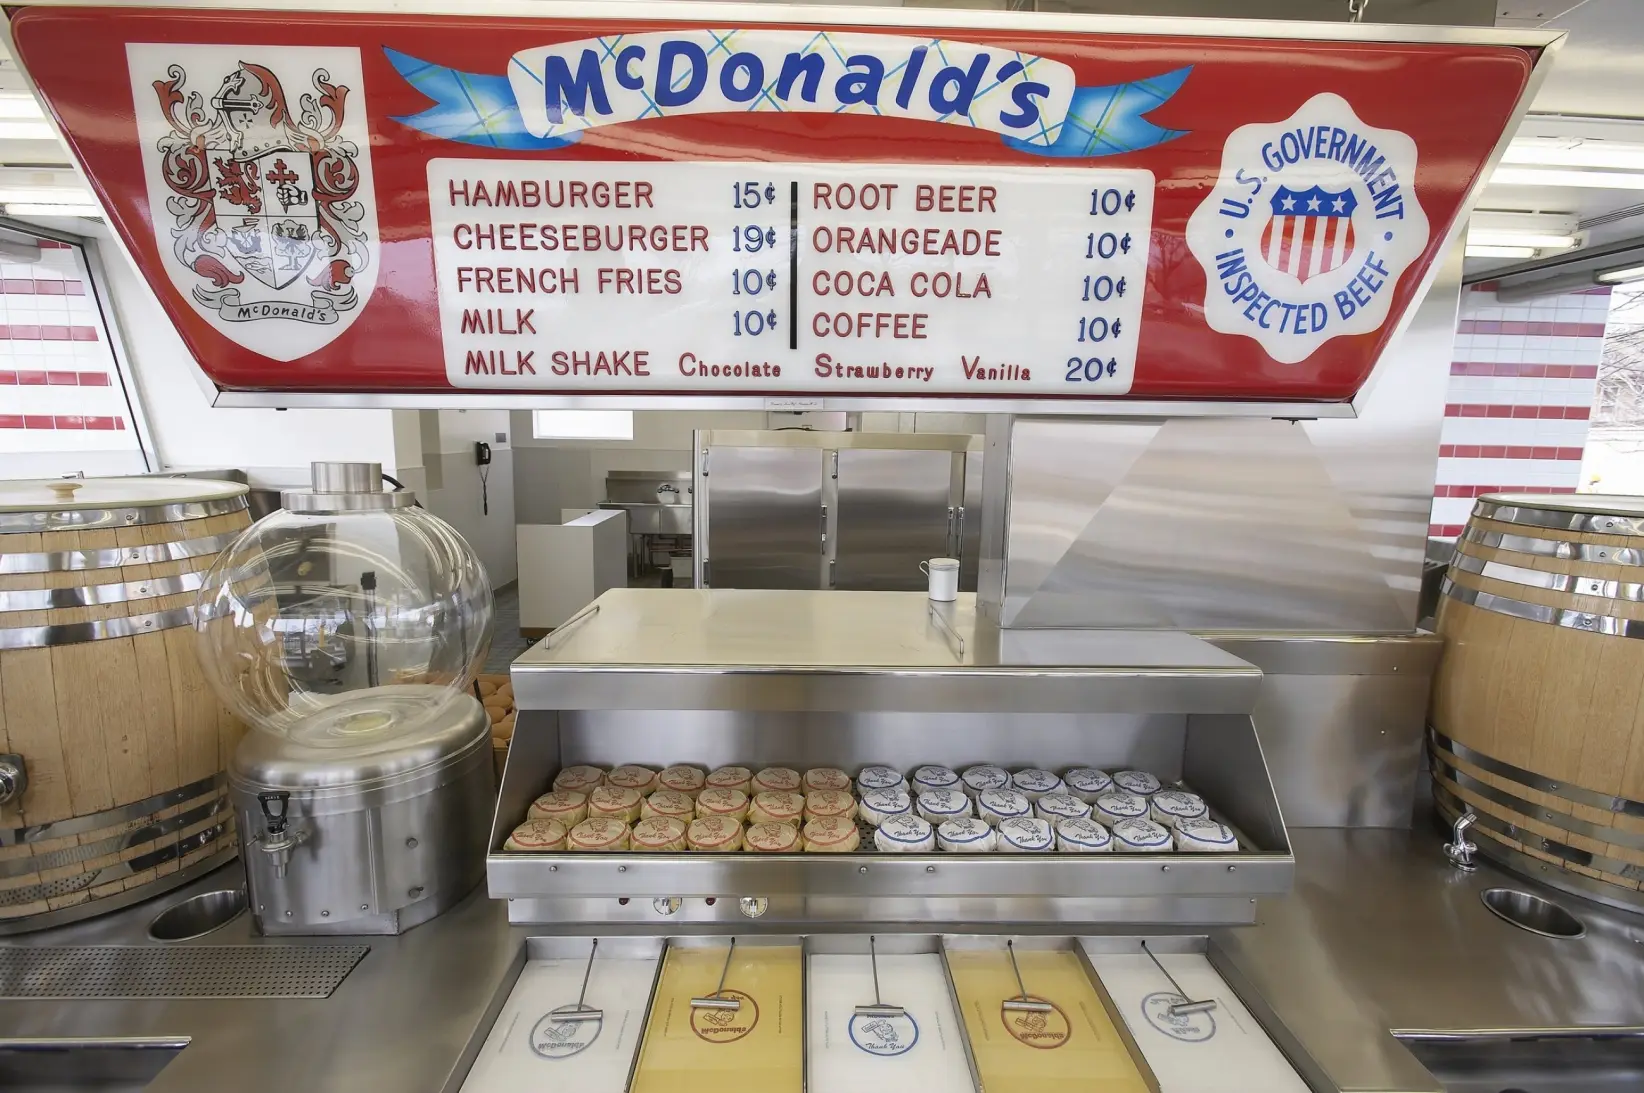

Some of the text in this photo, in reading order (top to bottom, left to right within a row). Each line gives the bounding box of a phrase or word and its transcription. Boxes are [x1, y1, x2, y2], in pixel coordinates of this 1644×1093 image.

[545, 41, 1050, 128] McDonald's
[1219, 126, 1404, 220] U.S. GOVERNMENT
[449, 180, 653, 208] HAMBURGER
[733, 182, 776, 209] 15¢
[814, 182, 997, 213] ROOT BEER
[1090, 188, 1136, 215] 10¢
[453, 224, 709, 252] CHEESEBURGER
[732, 225, 776, 252] 19¢
[812, 226, 1002, 256] ORANGEADE
[1086, 232, 1132, 259] 10¢
[457, 267, 682, 295] FRENCH FRIES
[732, 270, 776, 296] 10¢
[812, 270, 991, 299] COCA COLA
[1082, 276, 1127, 301] 10¢
[1216, 248, 1389, 334] INSPECTED BEEF
[238, 305, 326, 321] McDonald's
[461, 309, 537, 335] MILK
[732, 311, 776, 336] 10¢
[813, 312, 928, 339] COFFEE
[1077, 317, 1121, 342] 10¢
[465, 350, 1031, 382] MILK SHAKE Chocolate Strawberry Vanilla
[1065, 357, 1116, 382] 20¢
[1143, 782, 1154, 790] You
[939, 802, 951, 810] You
[948, 830, 966, 838] Thank
[1016, 835, 1048, 844] Thank You
[1134, 834, 1151, 842] Thank
[889, 1042, 905, 1050] You
